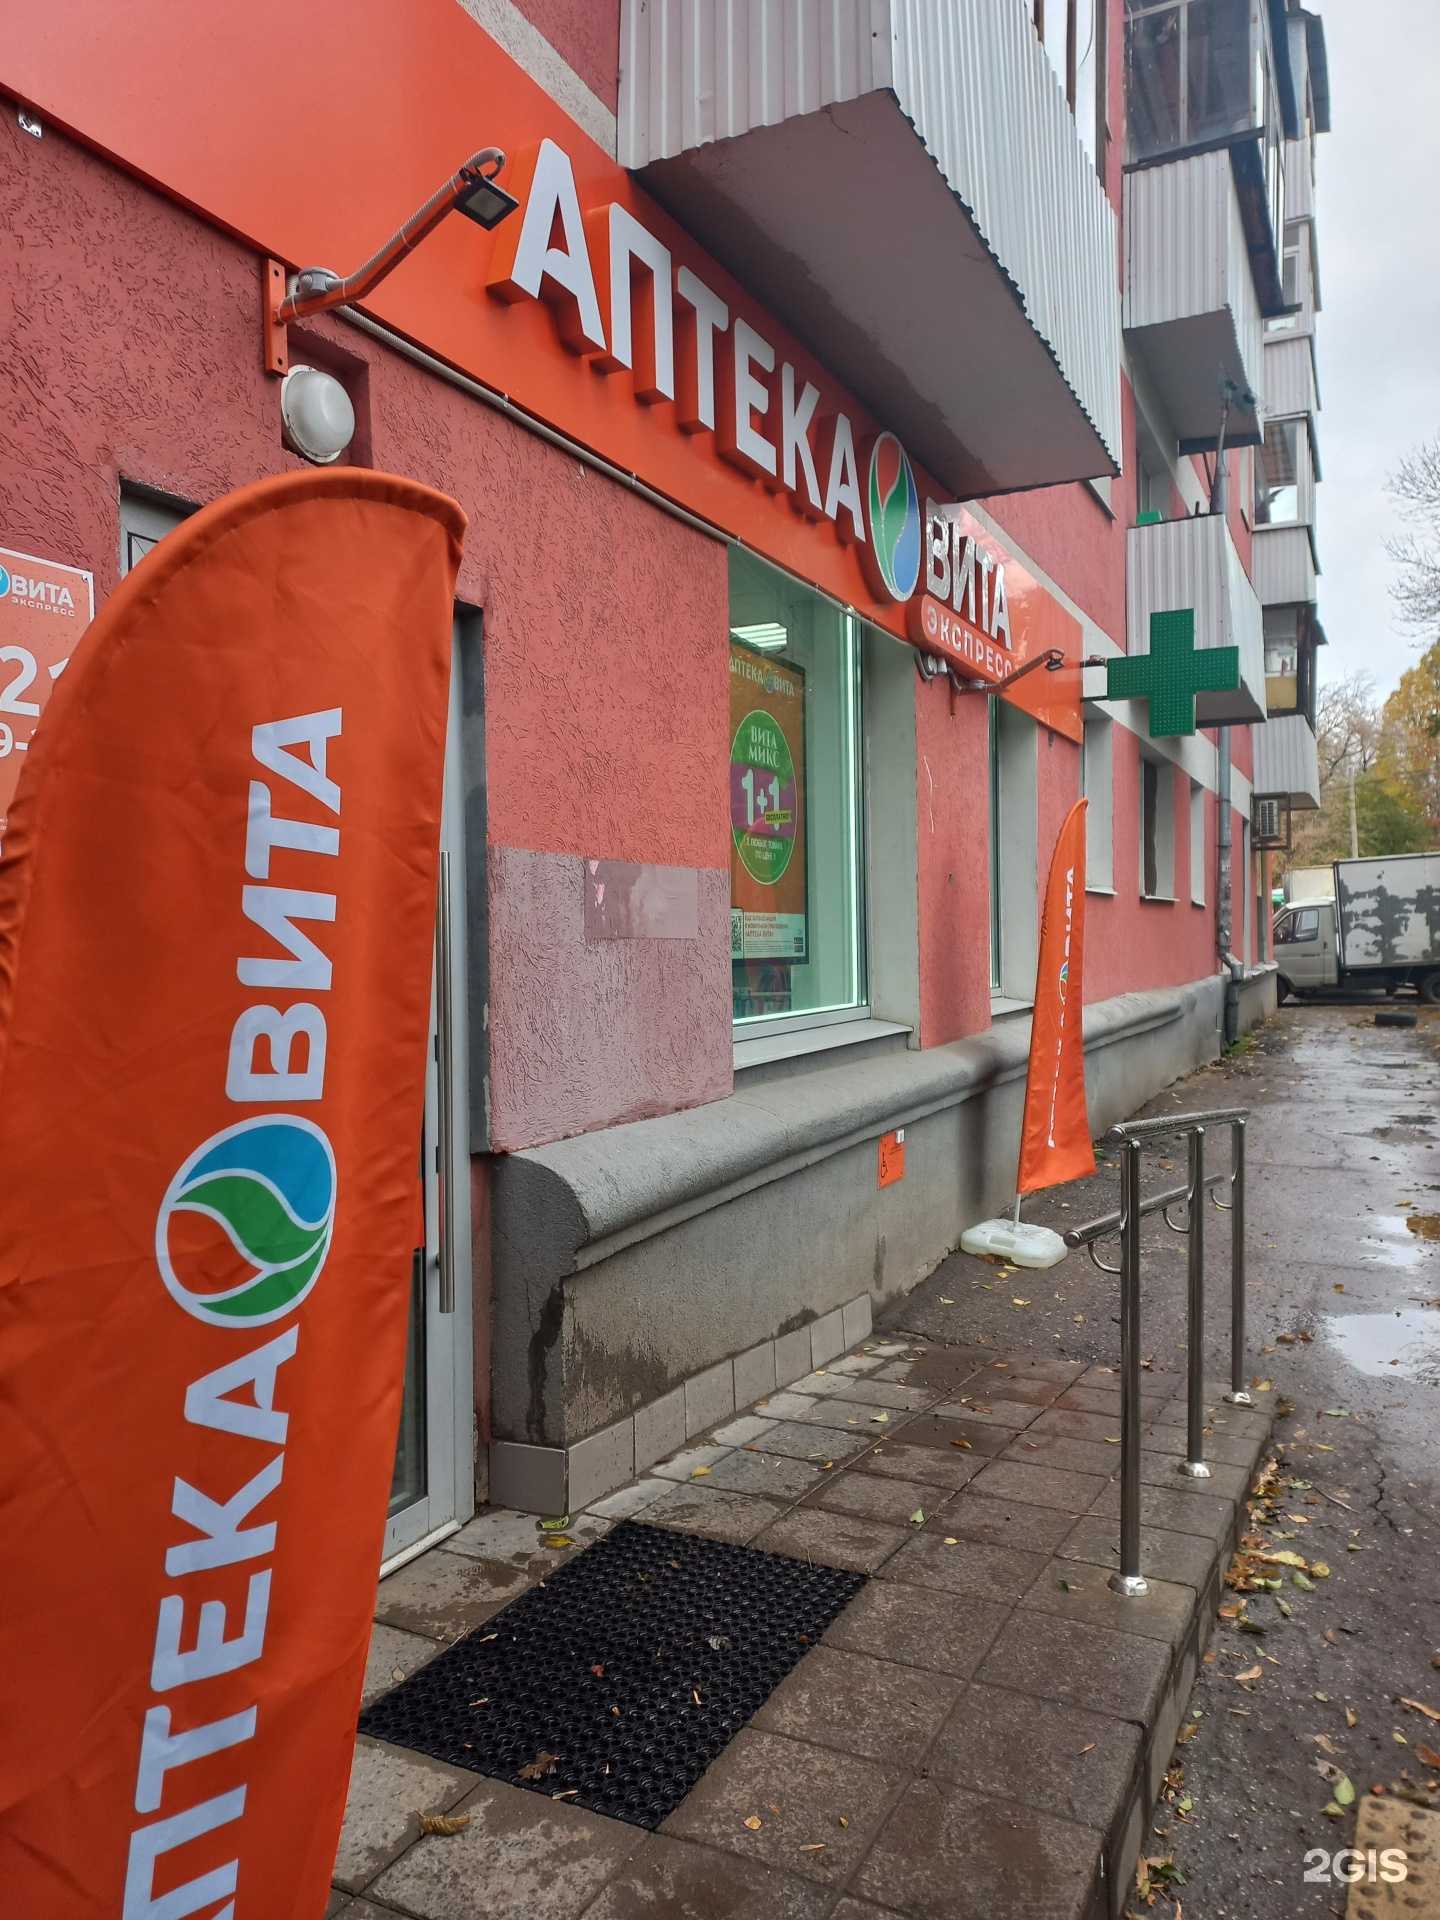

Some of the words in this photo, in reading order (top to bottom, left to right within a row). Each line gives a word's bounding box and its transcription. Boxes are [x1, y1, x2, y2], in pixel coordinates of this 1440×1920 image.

[510, 137, 867, 544] АПТЕКА
[926, 497, 1013, 651] ВИТА
[11, 574, 75, 608] ВИТА
[11, 596, 76, 617] ЭКСПРЕСС
[751, 726, 778, 749] ВИТА
[748, 743, 780, 768] МИКС
[121, 1322, 301, 1920] ПТЕКА
[225, 706, 344, 1104] ВИТА
